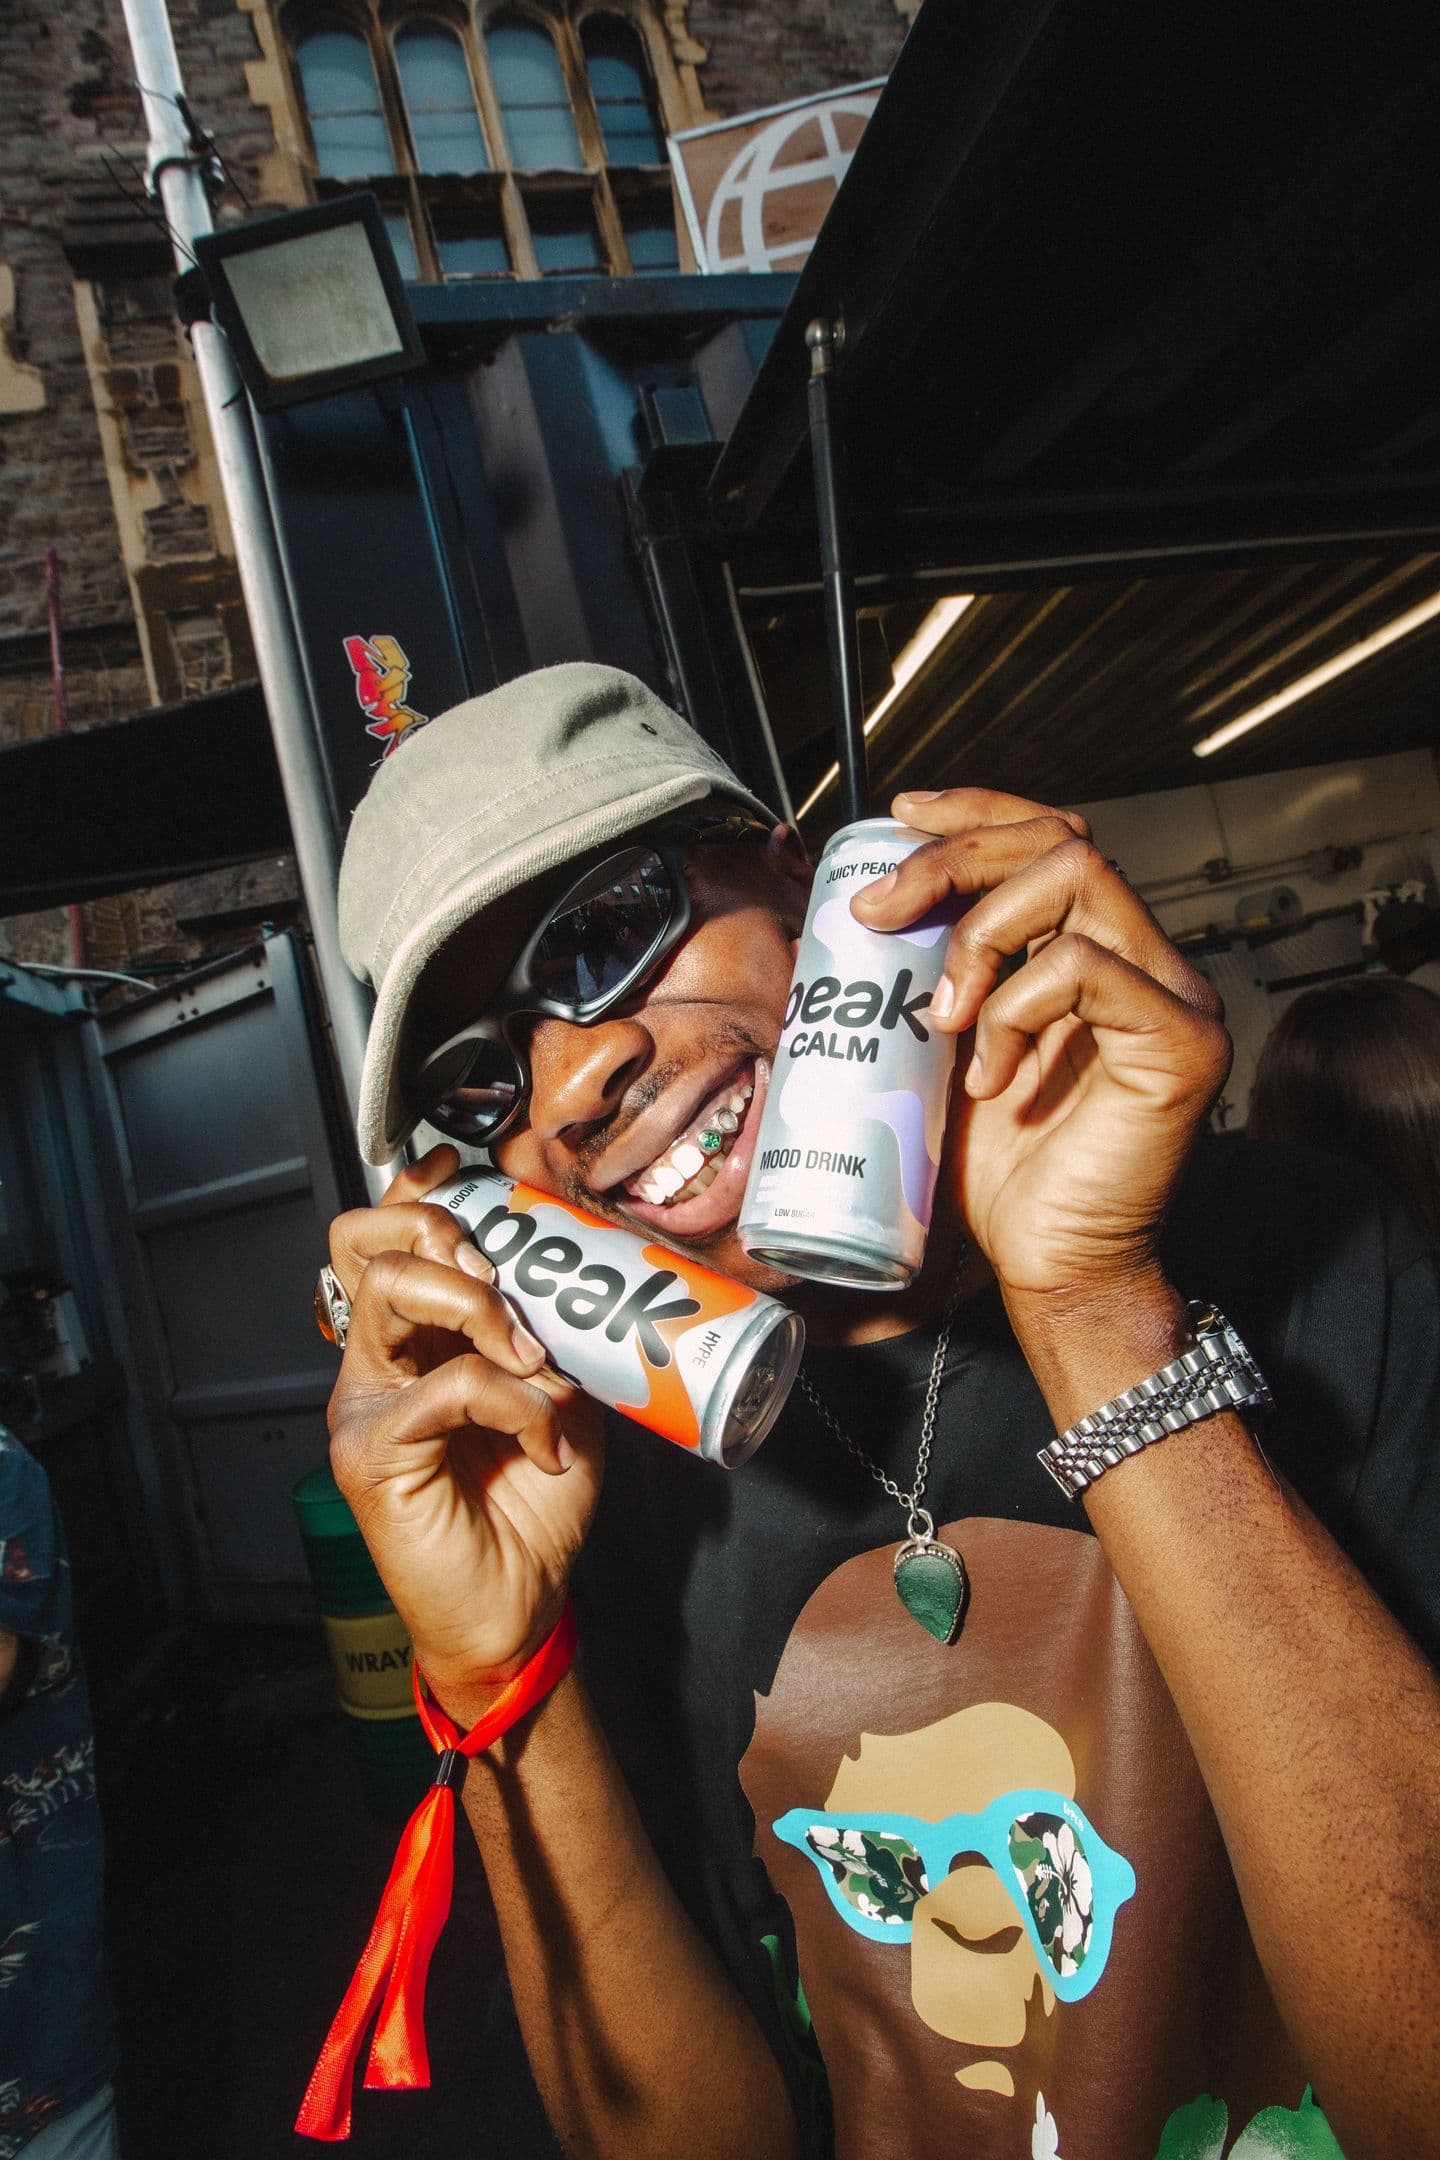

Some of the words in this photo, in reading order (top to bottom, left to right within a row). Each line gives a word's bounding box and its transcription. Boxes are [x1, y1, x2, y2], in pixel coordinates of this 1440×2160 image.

[826, 863, 859, 884] JUICY
[789, 1031, 880, 1063] CALM
[760, 1148, 801, 1171] MOOD
[805, 1150, 867, 1179] DRINK
[448, 1182, 479, 1209] MOOD
[774, 1207, 790, 1217] LOW
[470, 1205, 701, 1368] peak
[692, 1330, 721, 1369] HYPE
[345, 1645, 411, 1673] WRAY
